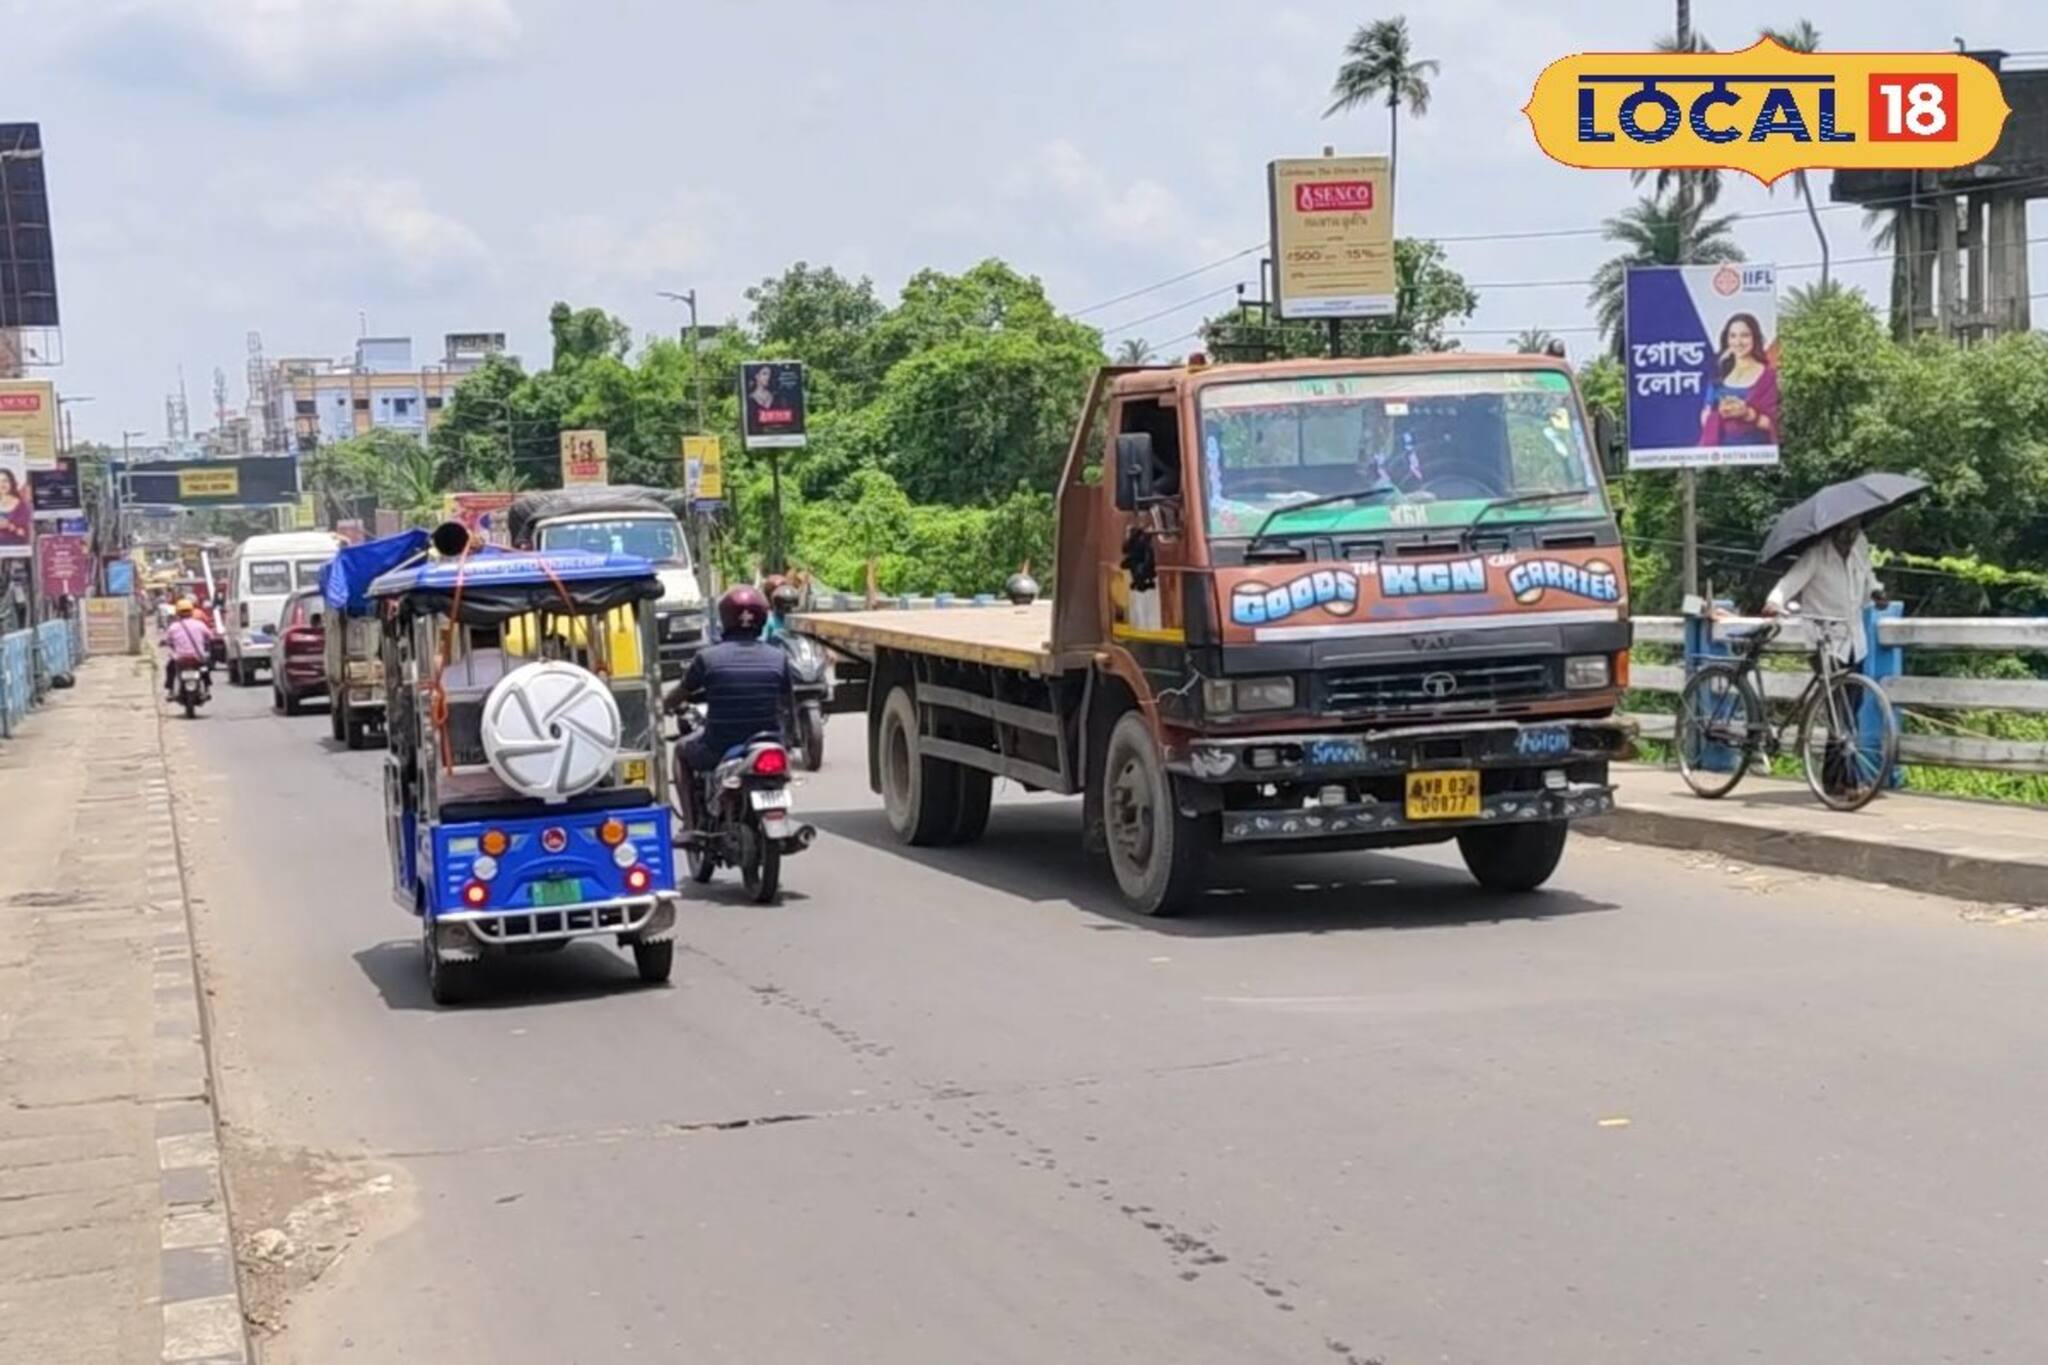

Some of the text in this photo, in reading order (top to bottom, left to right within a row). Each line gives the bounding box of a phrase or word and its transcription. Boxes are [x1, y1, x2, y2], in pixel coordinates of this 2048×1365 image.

[1313, 186, 1369, 201] SENCO
[1742, 270, 1774, 285] IIFL
[1632, 340, 1706, 367] গোল্ড
[1635, 371, 1704, 396] লোন
[1231, 569, 1358, 624] GOODS
[1380, 555, 1486, 595] KGN
